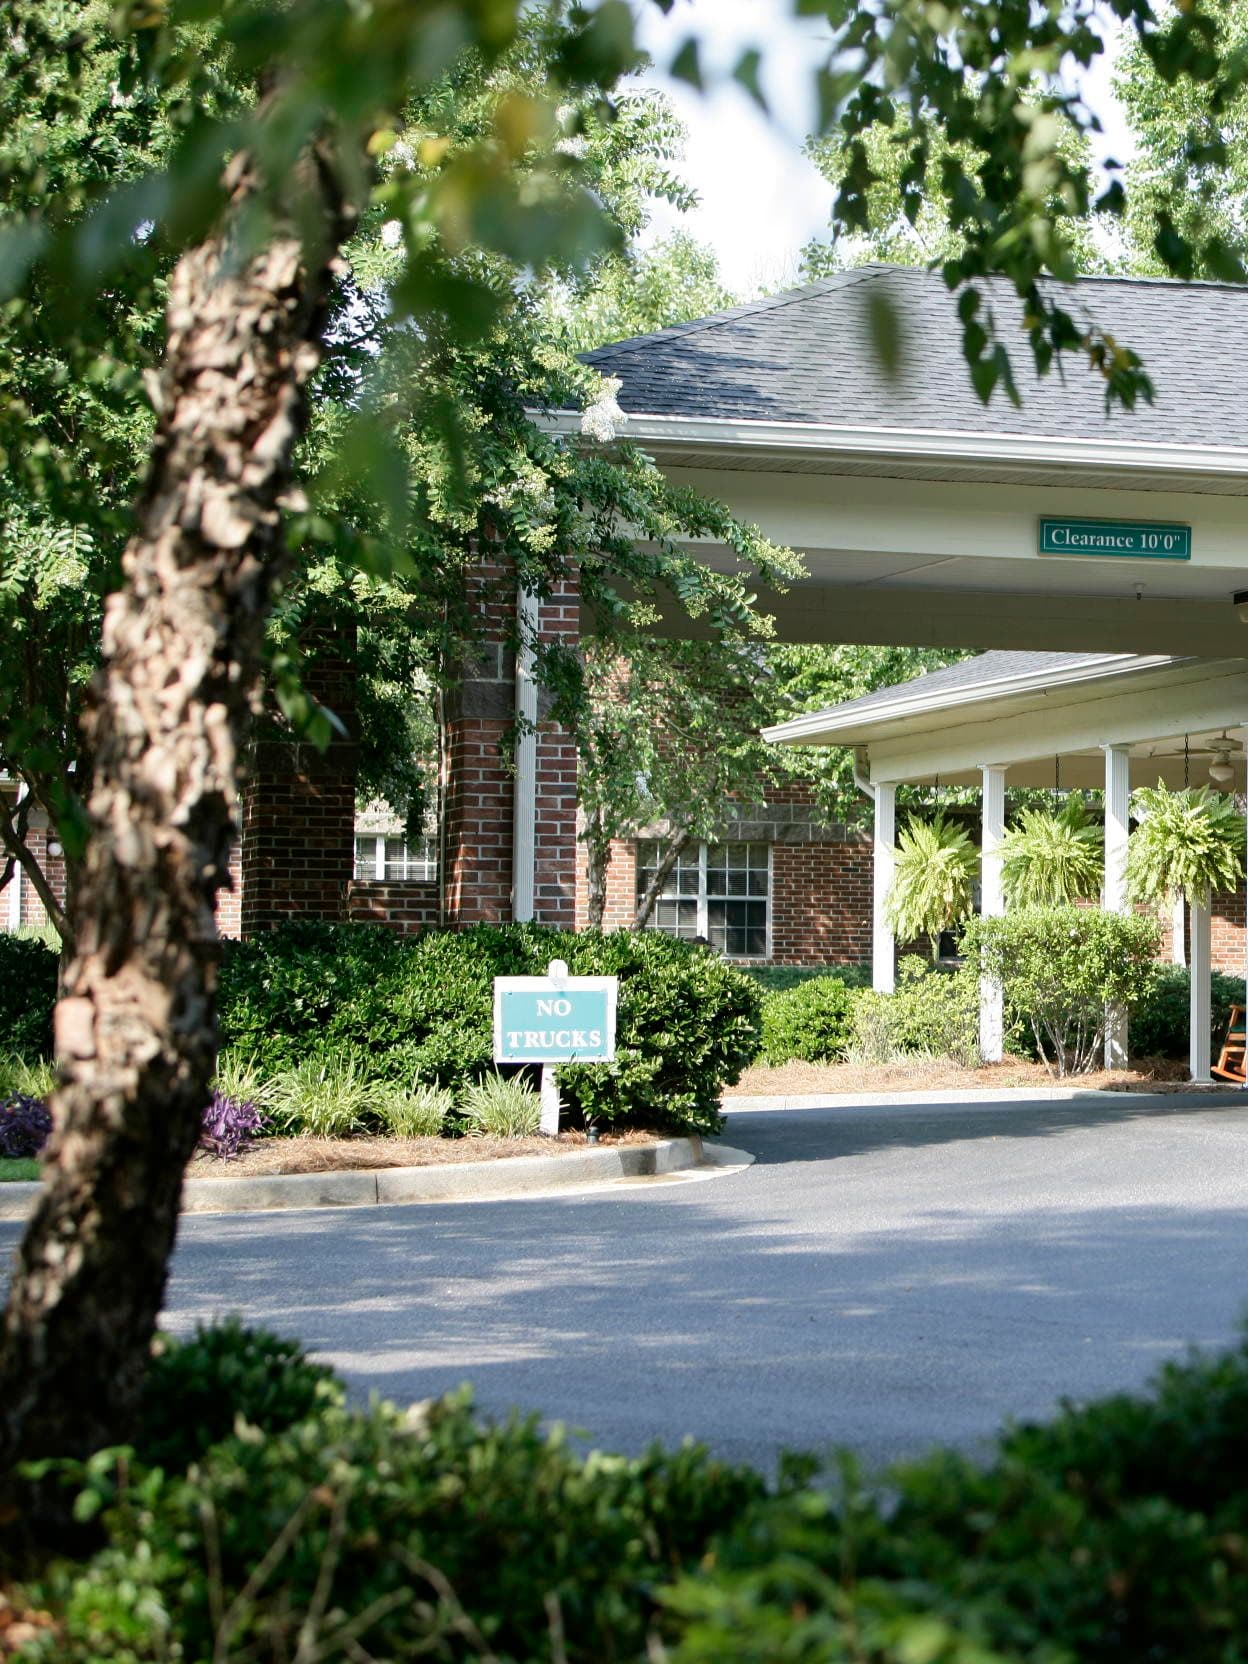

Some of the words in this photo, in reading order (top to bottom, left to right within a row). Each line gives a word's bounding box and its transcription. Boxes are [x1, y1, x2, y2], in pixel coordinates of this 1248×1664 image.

[1051, 528, 1134, 548] Clearance
[536, 999, 572, 1016] NO
[507, 1030, 602, 1048] TRUCKS
